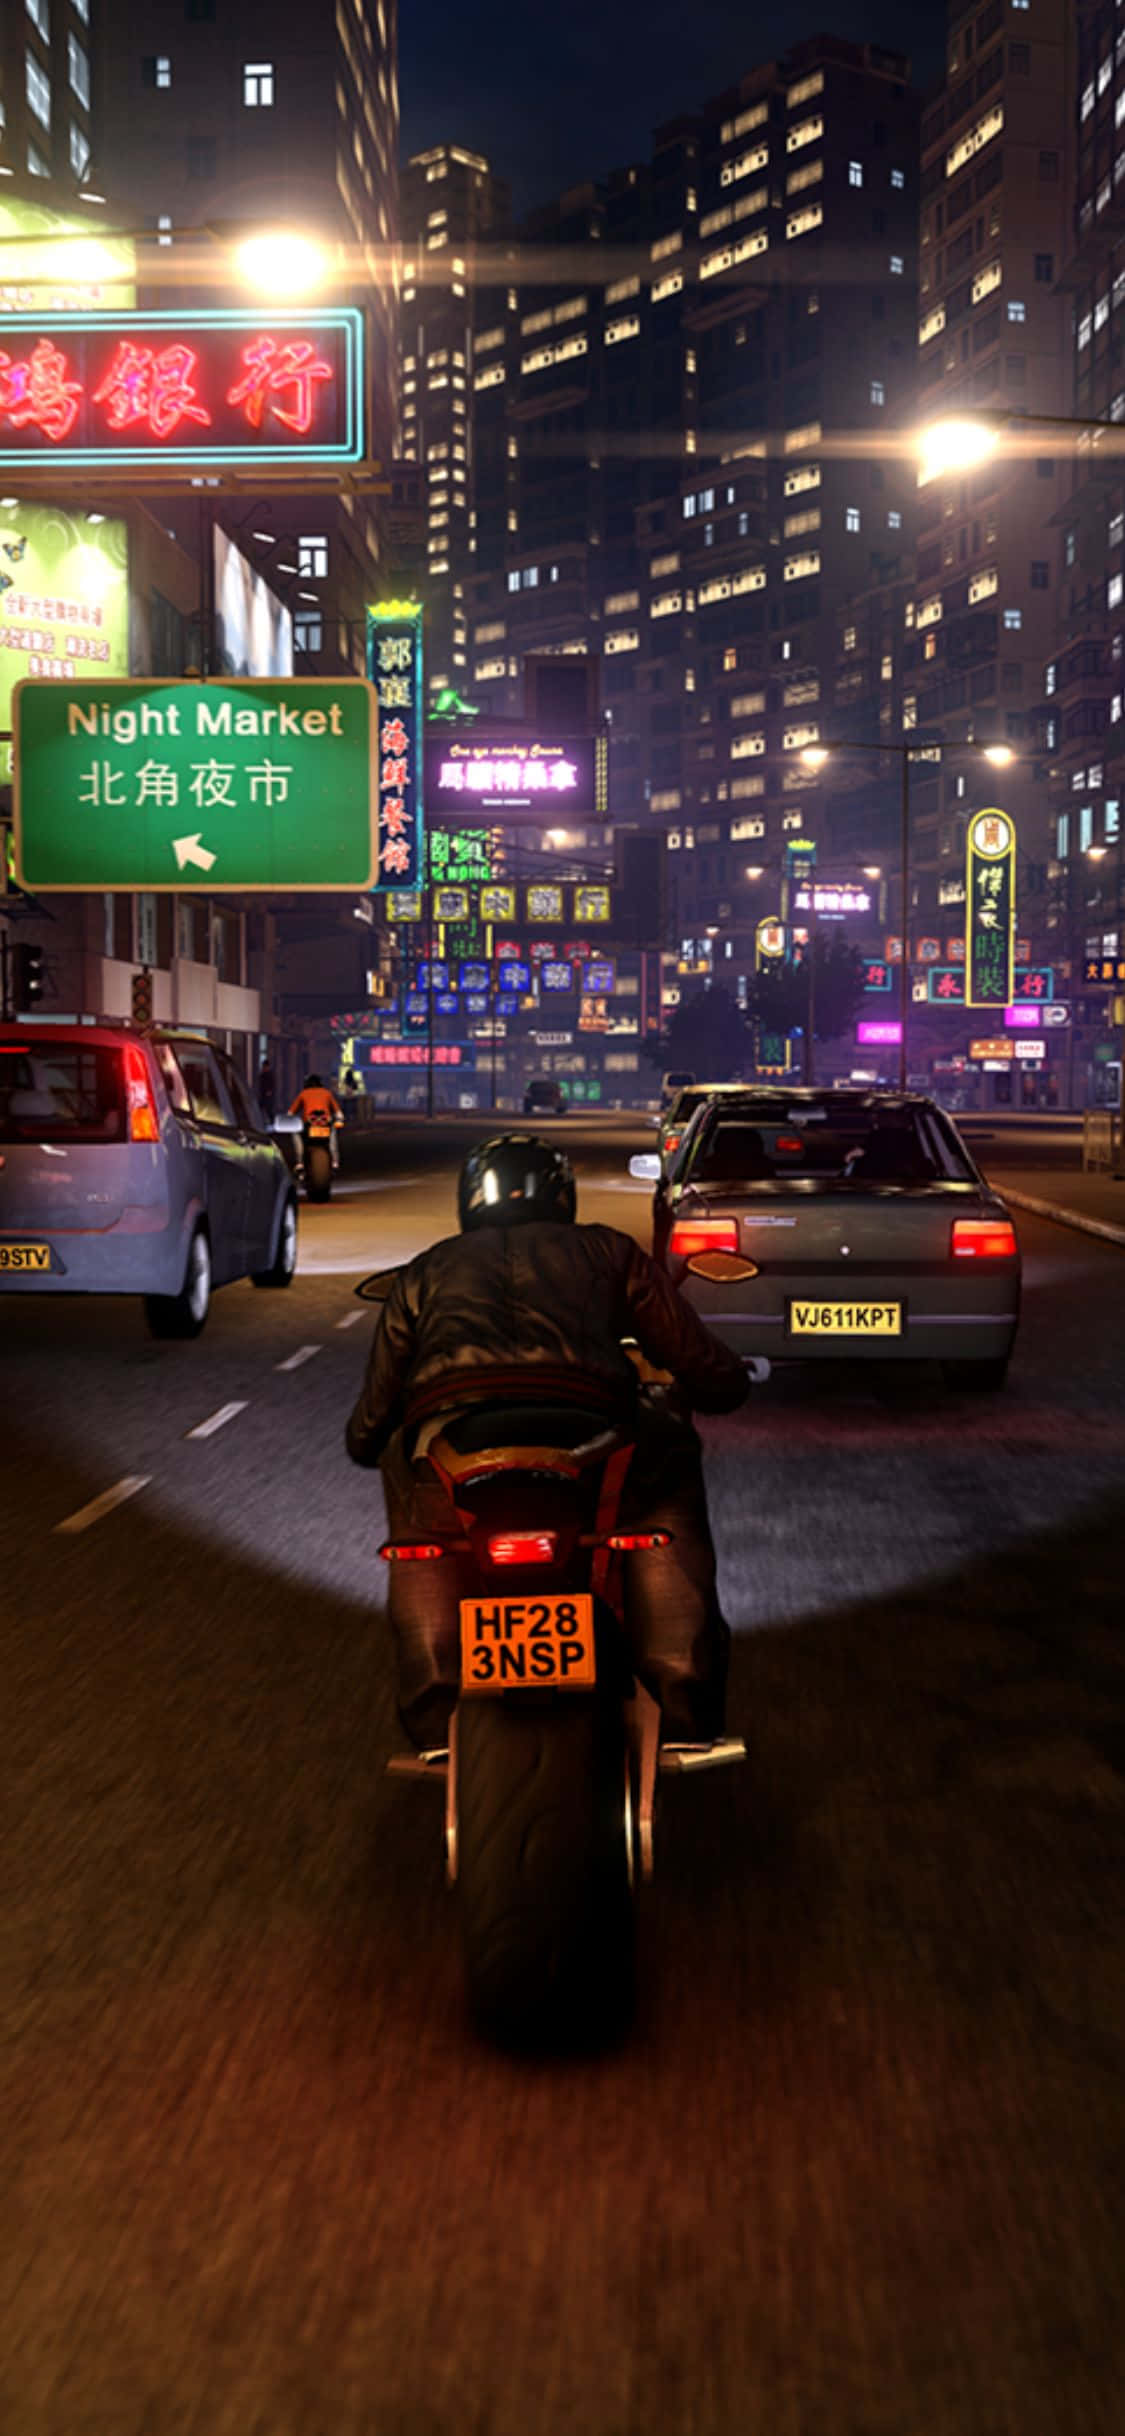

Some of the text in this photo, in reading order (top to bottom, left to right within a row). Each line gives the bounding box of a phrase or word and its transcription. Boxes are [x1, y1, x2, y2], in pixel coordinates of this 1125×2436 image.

[67, 703, 344, 744] Night Market
[79, 759, 293, 807] 北角夜市
[795, 1307, 897, 1328] VJ611KPT
[475, 1602, 579, 1641] HF28
[471, 1641, 585, 1680] 3NSP
